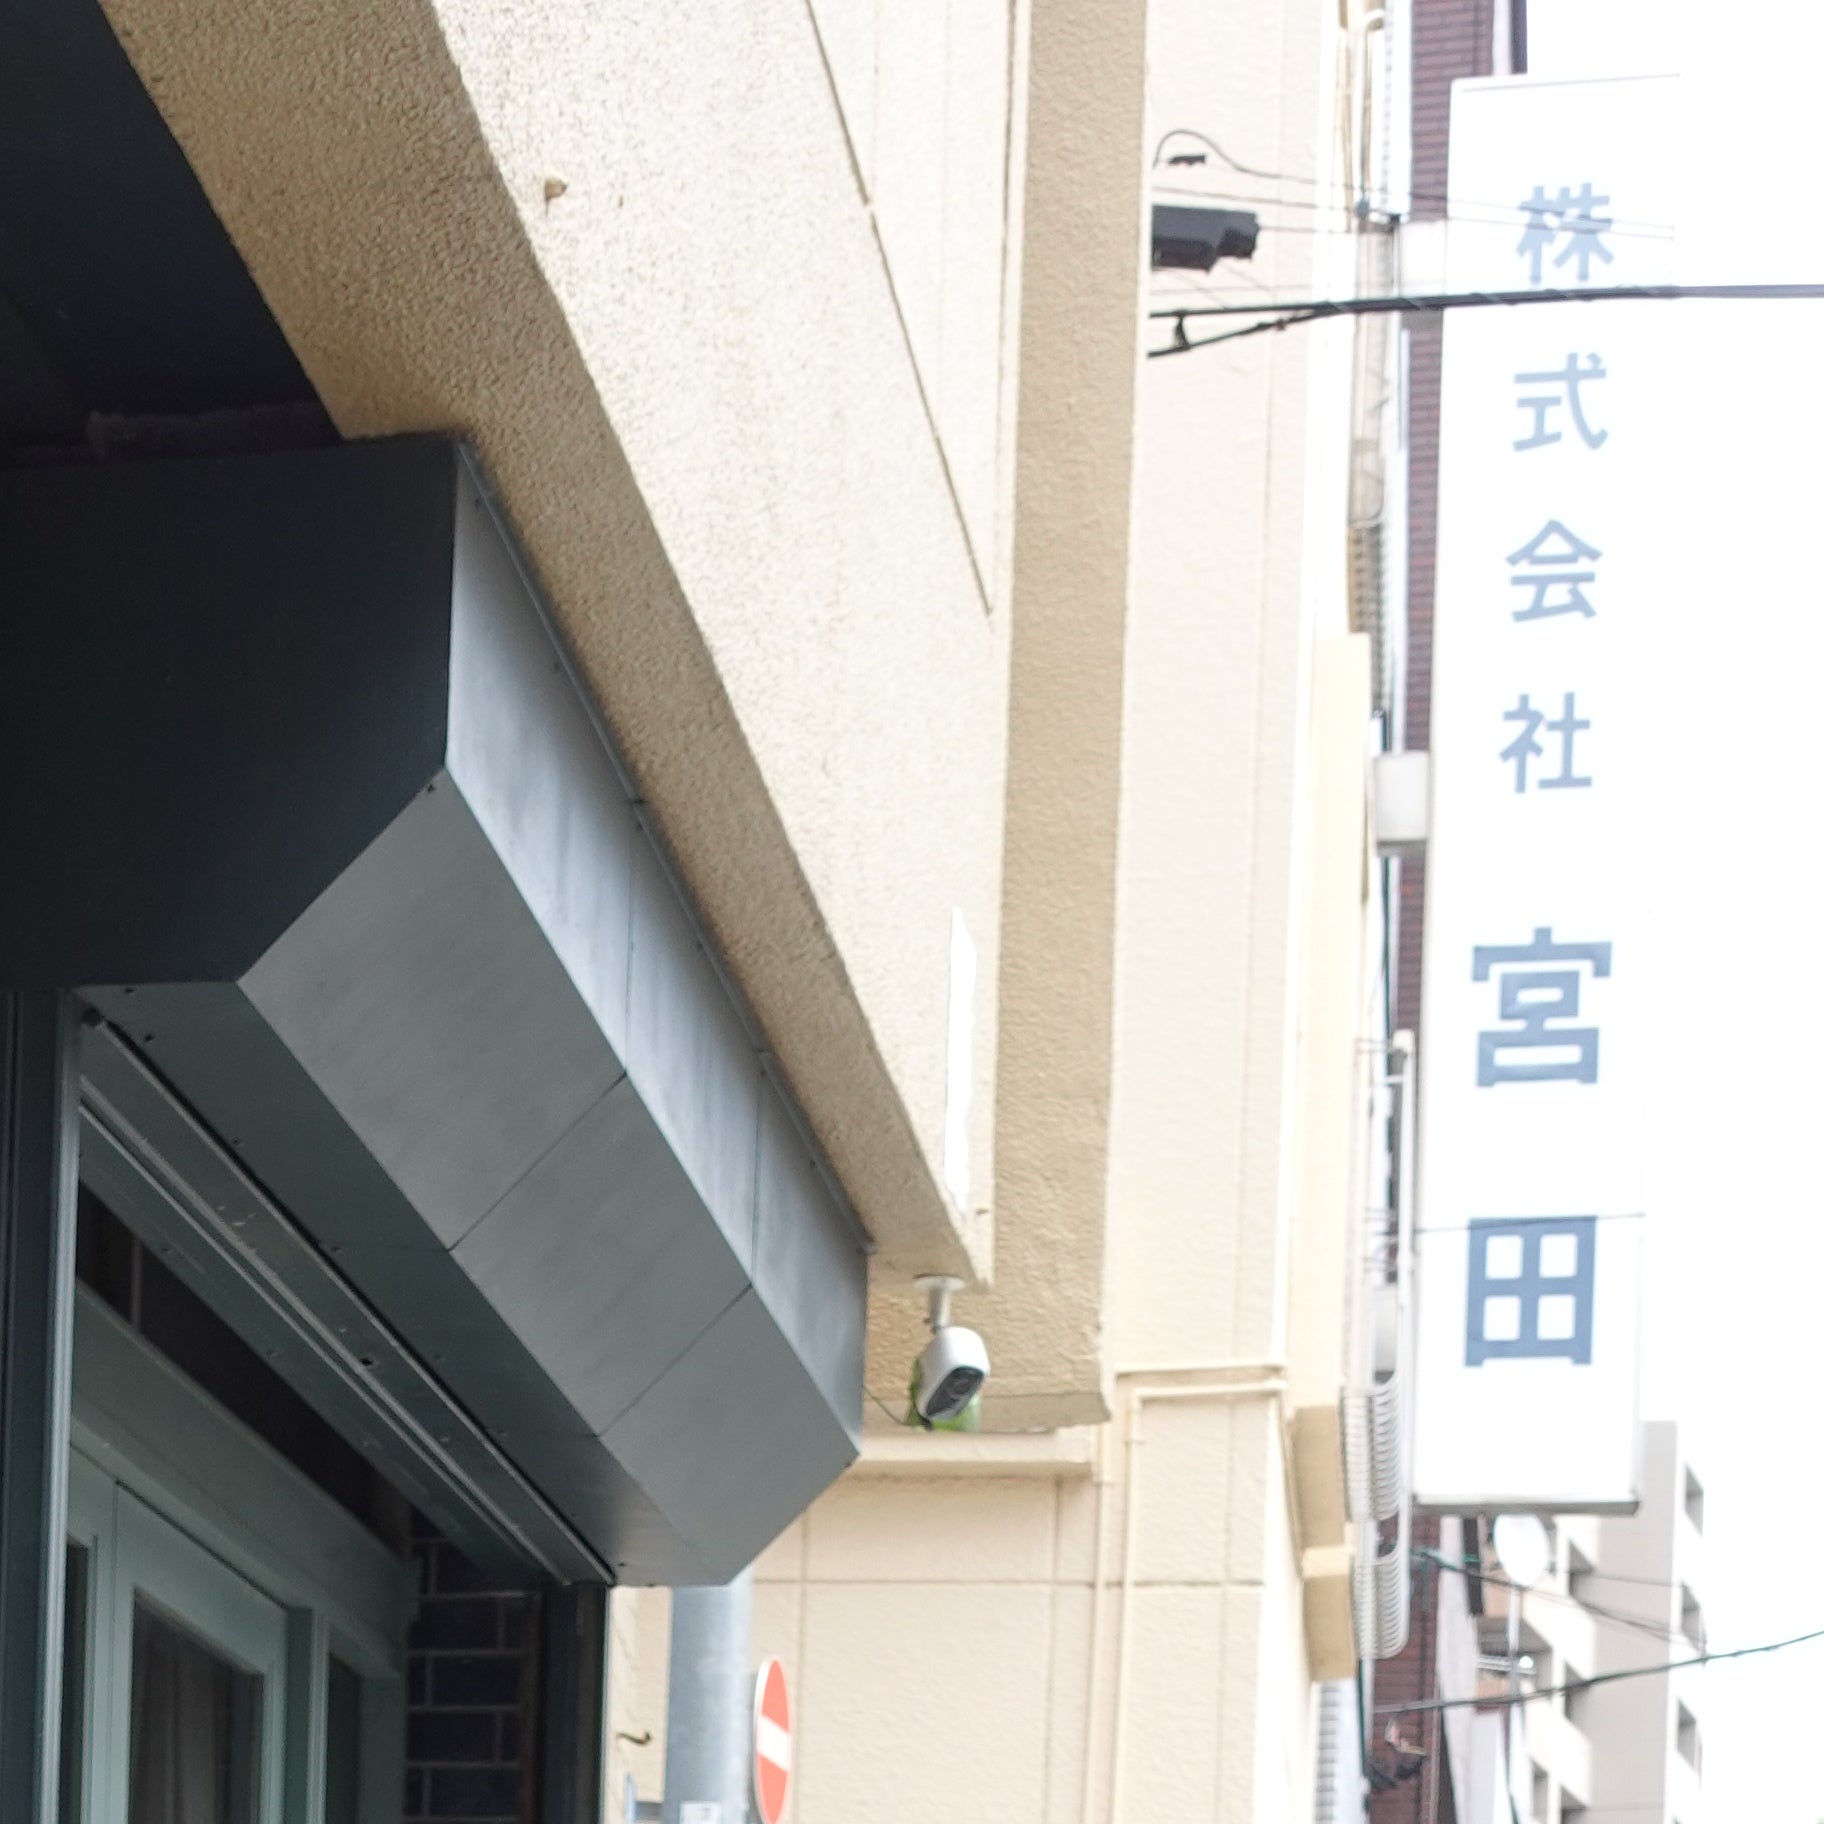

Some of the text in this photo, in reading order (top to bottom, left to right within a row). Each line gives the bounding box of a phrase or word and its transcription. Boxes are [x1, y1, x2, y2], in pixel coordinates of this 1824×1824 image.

[1464, 183, 1613, 1369] 株式会社宮田
